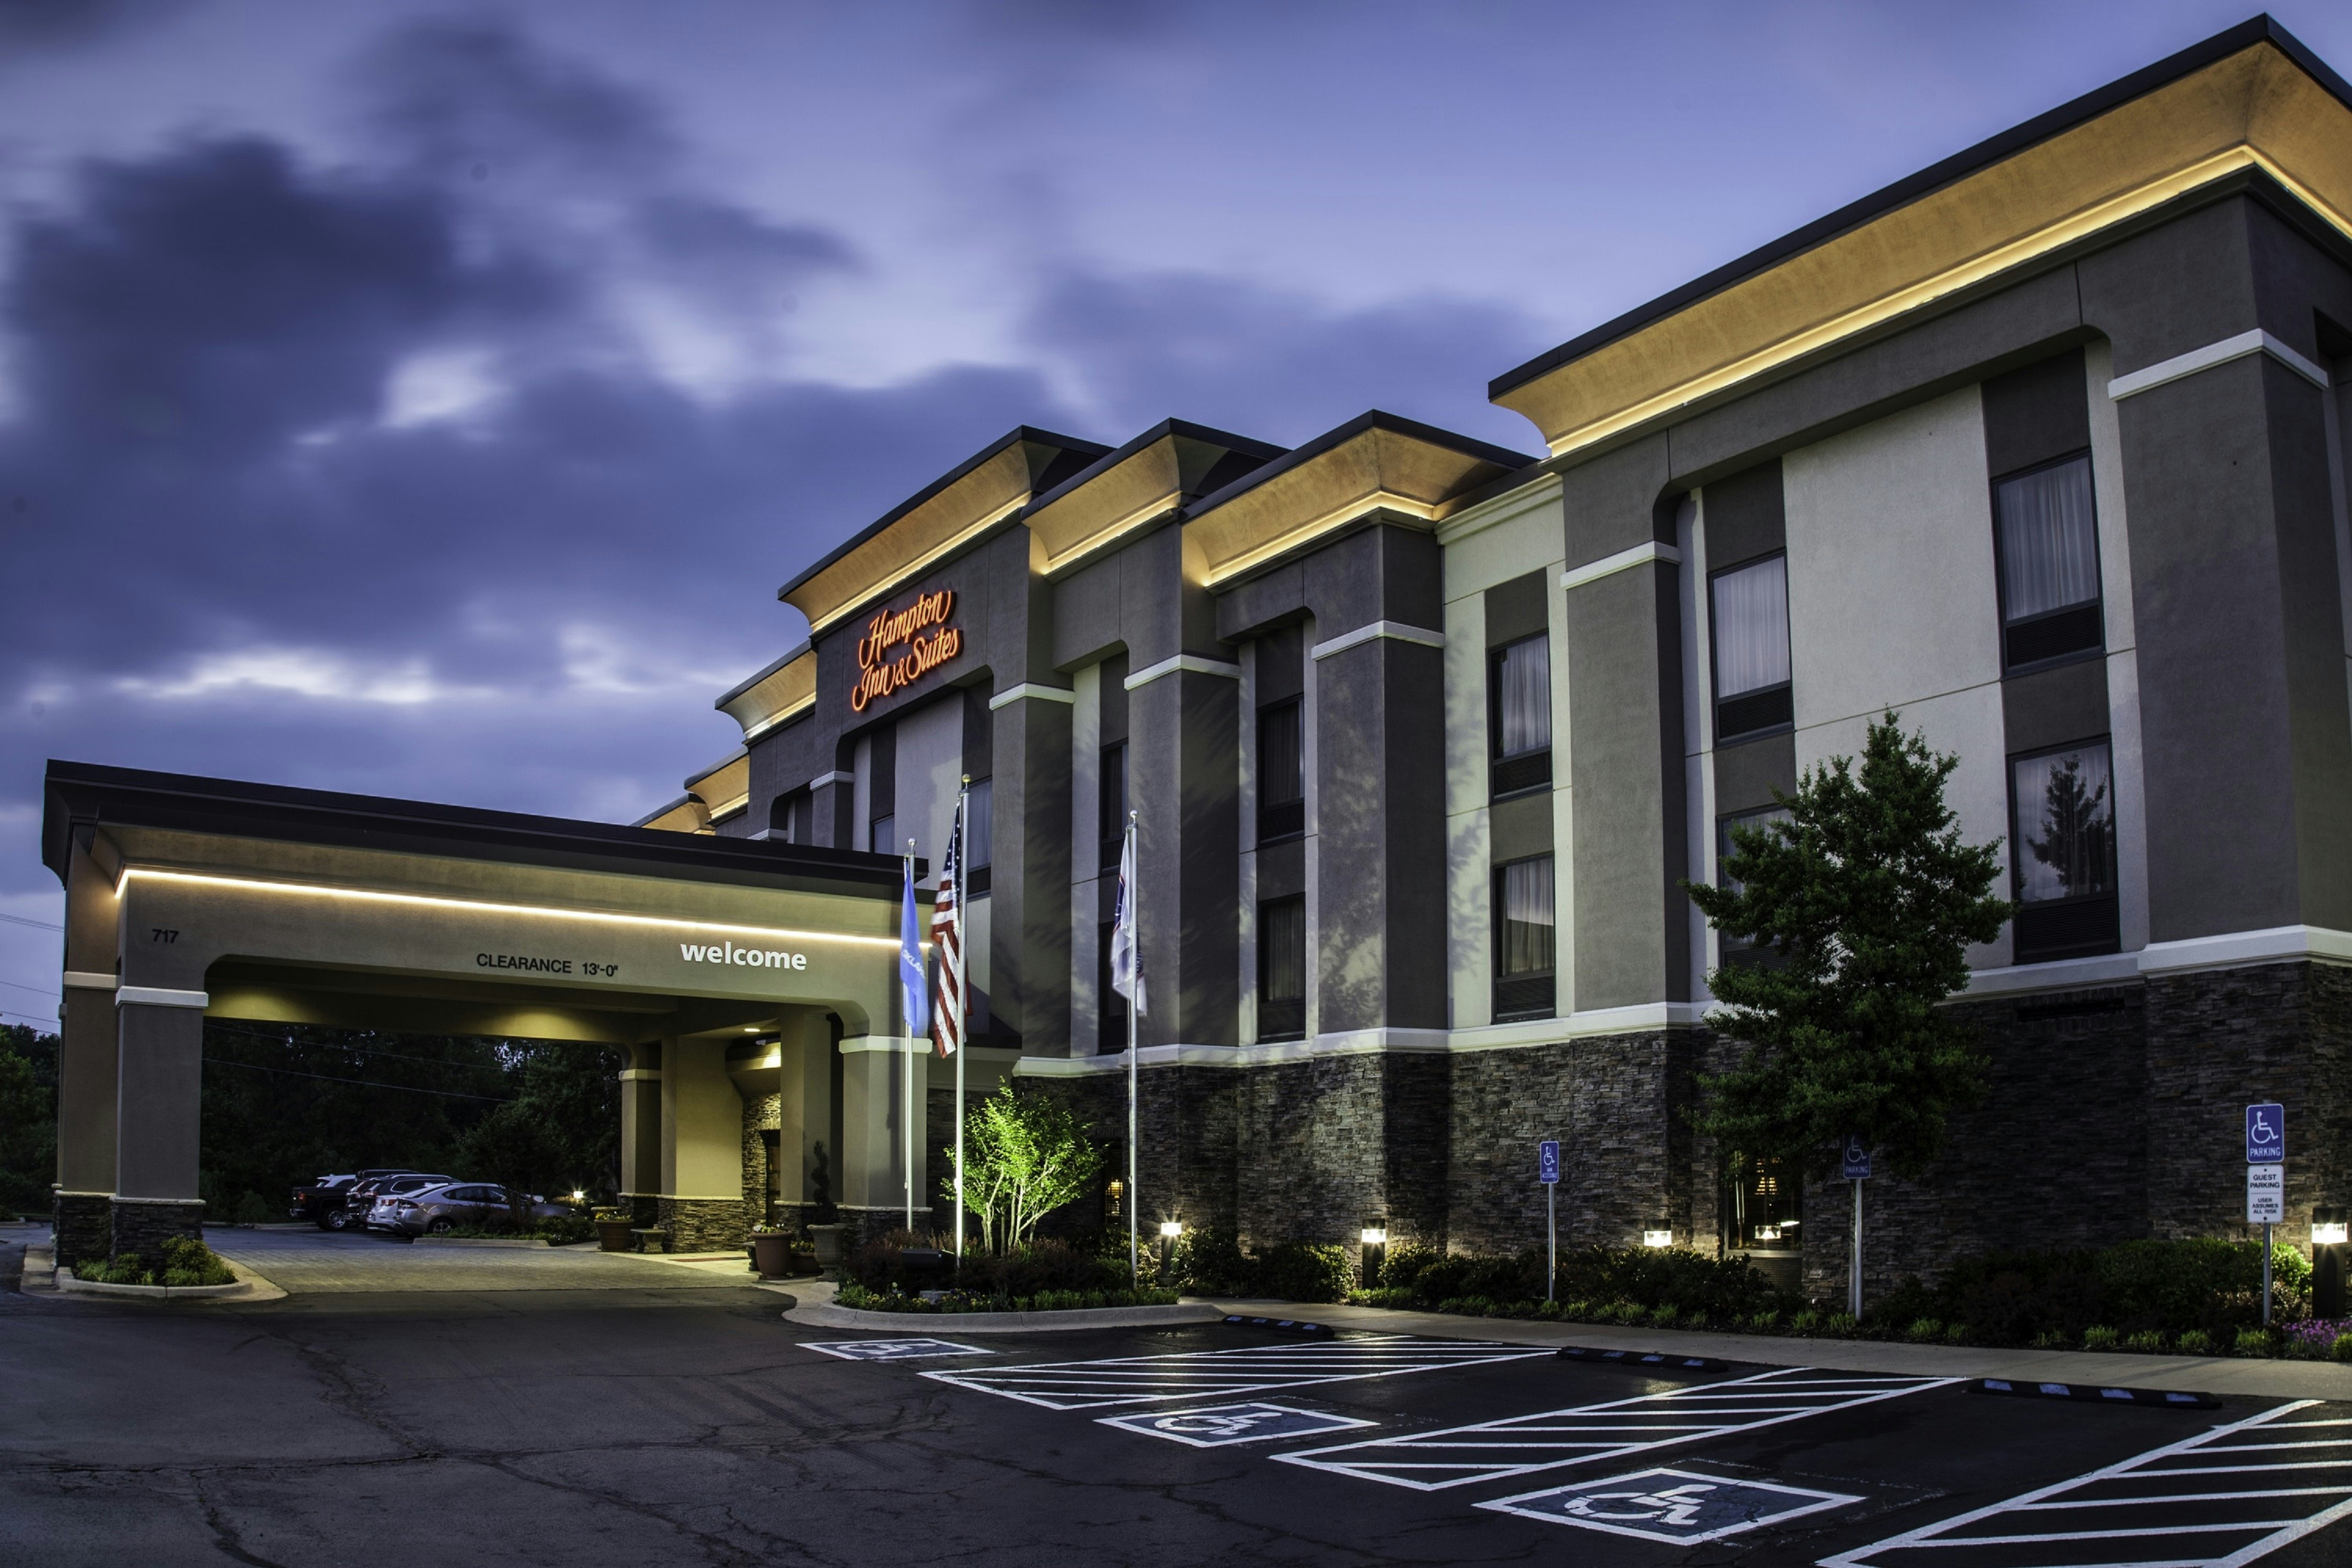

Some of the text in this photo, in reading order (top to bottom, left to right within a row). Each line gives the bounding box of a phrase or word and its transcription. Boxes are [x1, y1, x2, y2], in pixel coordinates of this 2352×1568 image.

[859, 590, 952, 670] Hampton
[852, 626, 959, 711] Inn & Suites
[152, 928, 179, 943] 717
[476, 953, 619, 977] CLEARANCE 13'-0"
[680, 941, 807, 971] welcome
[2250, 1147, 2281, 1157] PARKING
